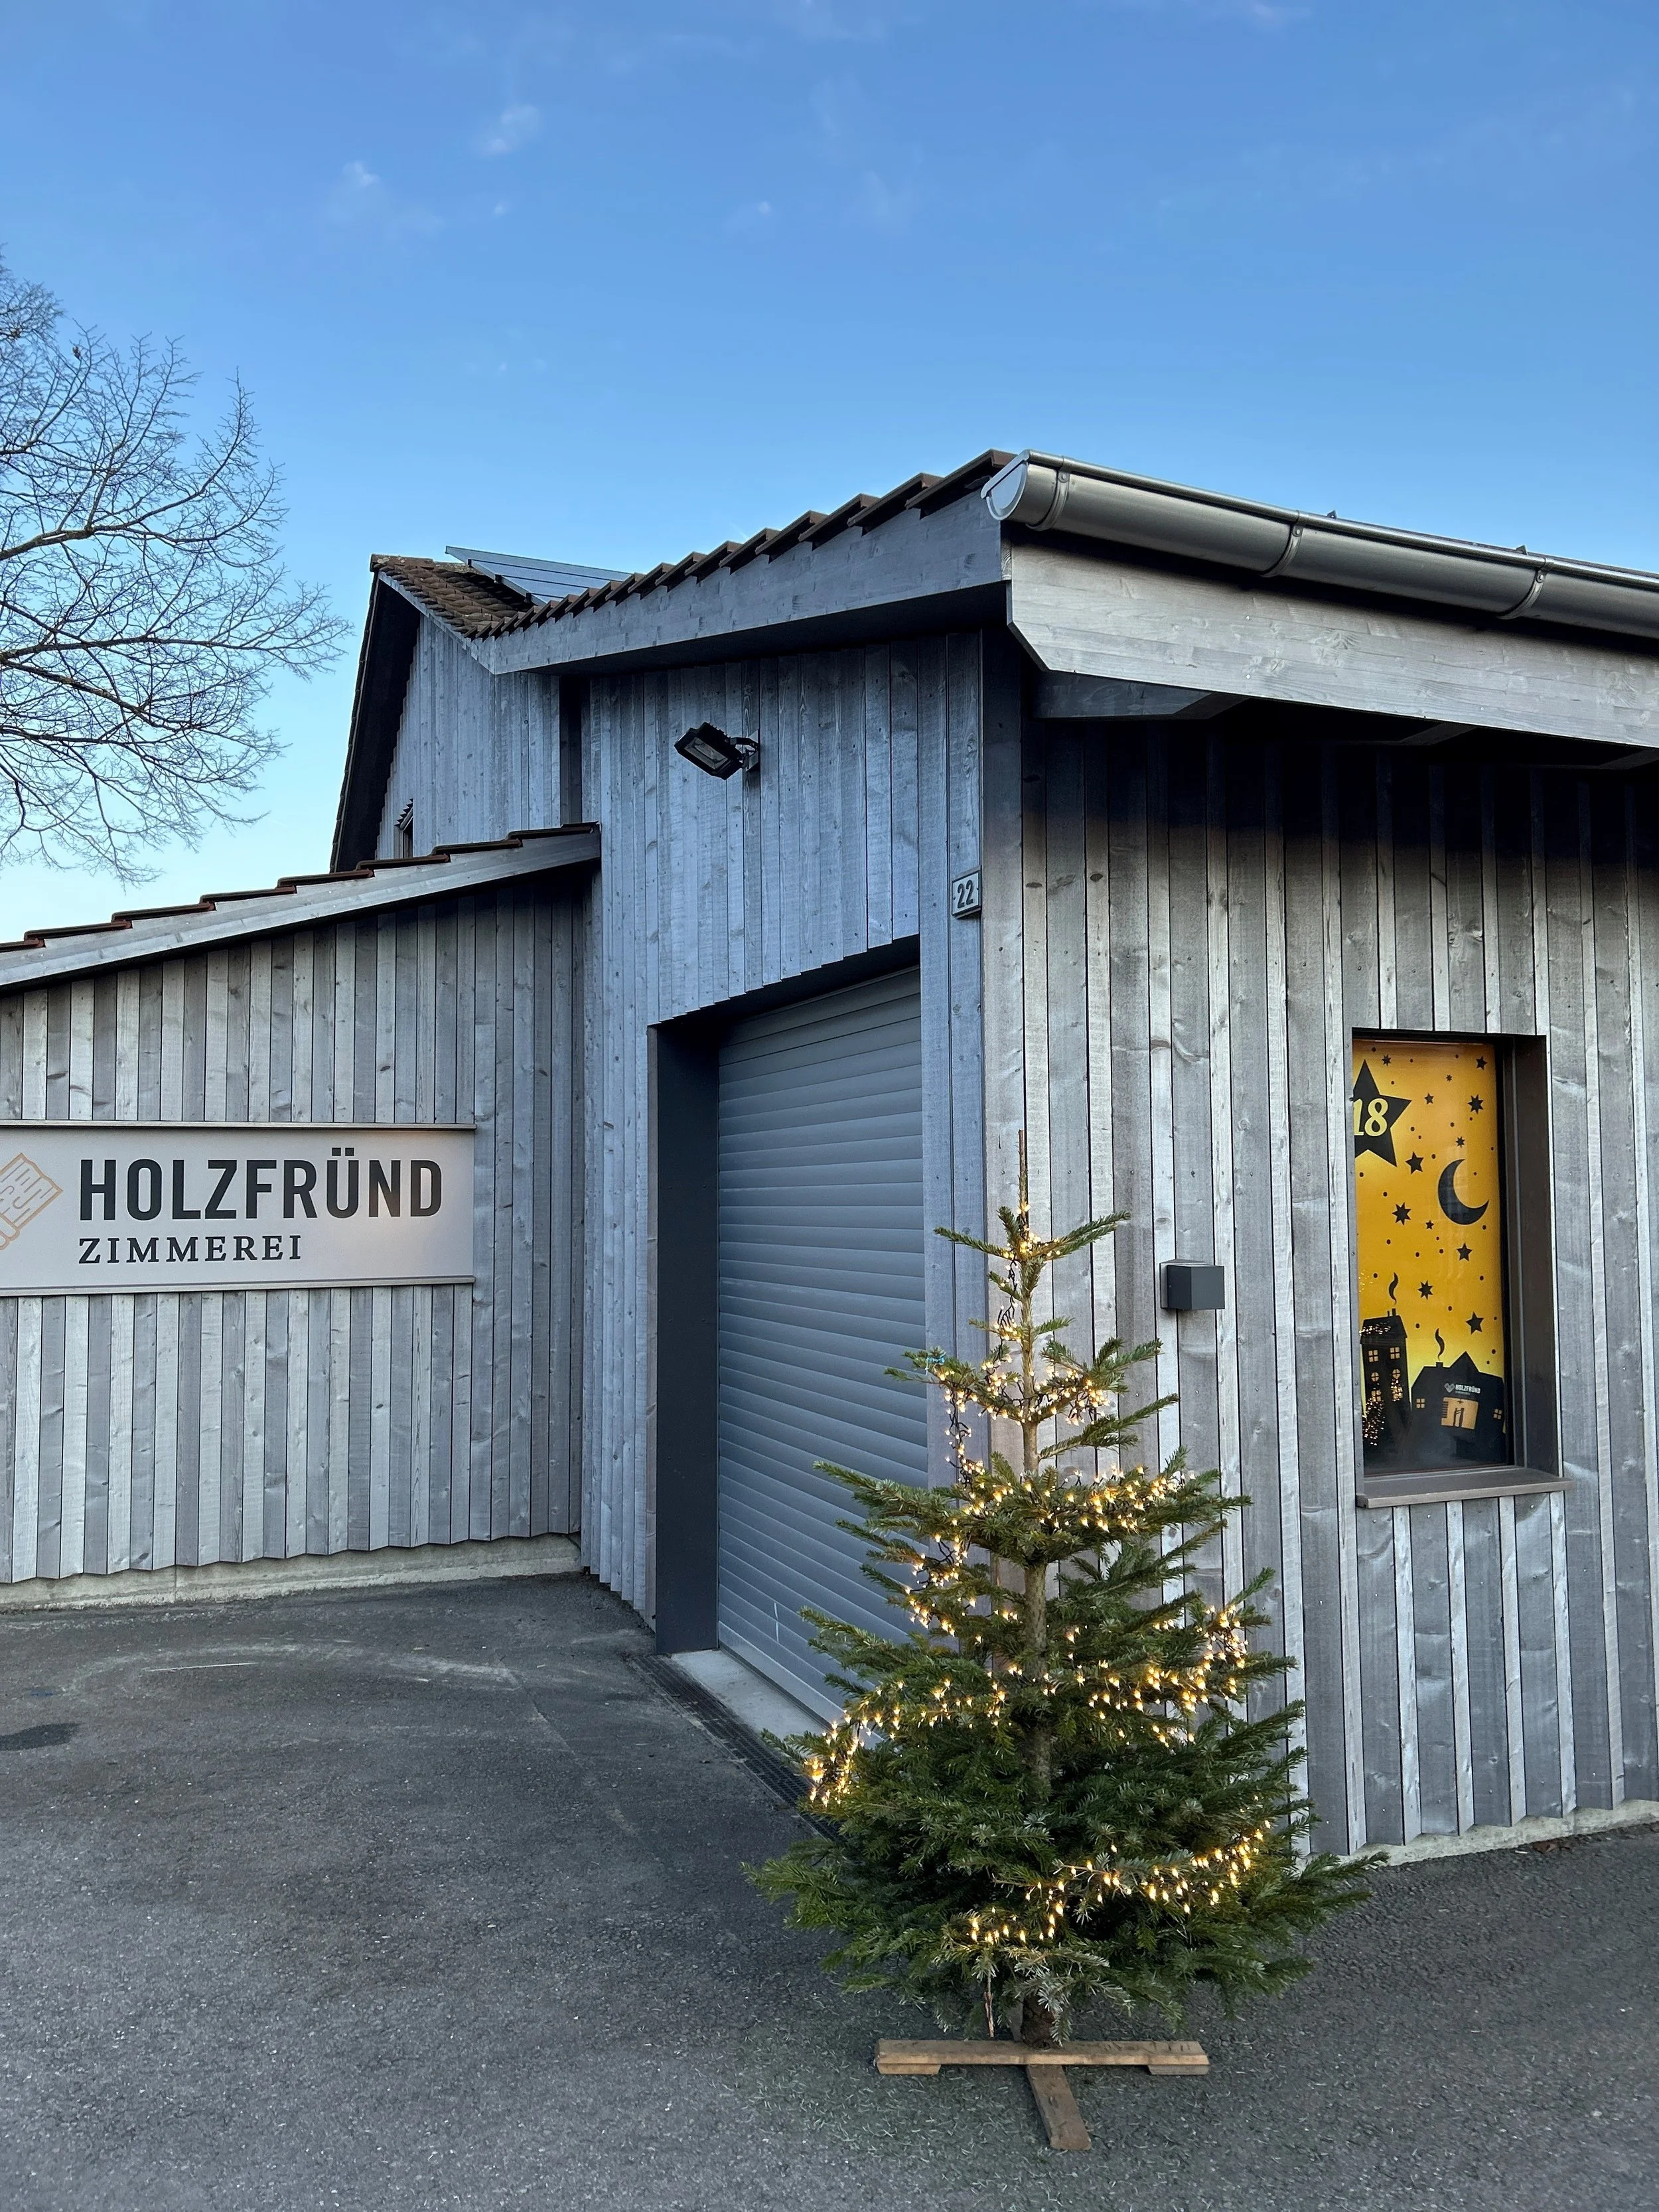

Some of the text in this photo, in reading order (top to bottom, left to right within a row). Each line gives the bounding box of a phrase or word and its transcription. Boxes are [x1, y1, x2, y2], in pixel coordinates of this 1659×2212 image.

[957, 879, 974, 909] 22
[1353, 1098, 1388, 1136] 18
[80, 1147, 442, 1220] HOLZFRÜND
[79, 1235, 301, 1264] ZIMMEREI
